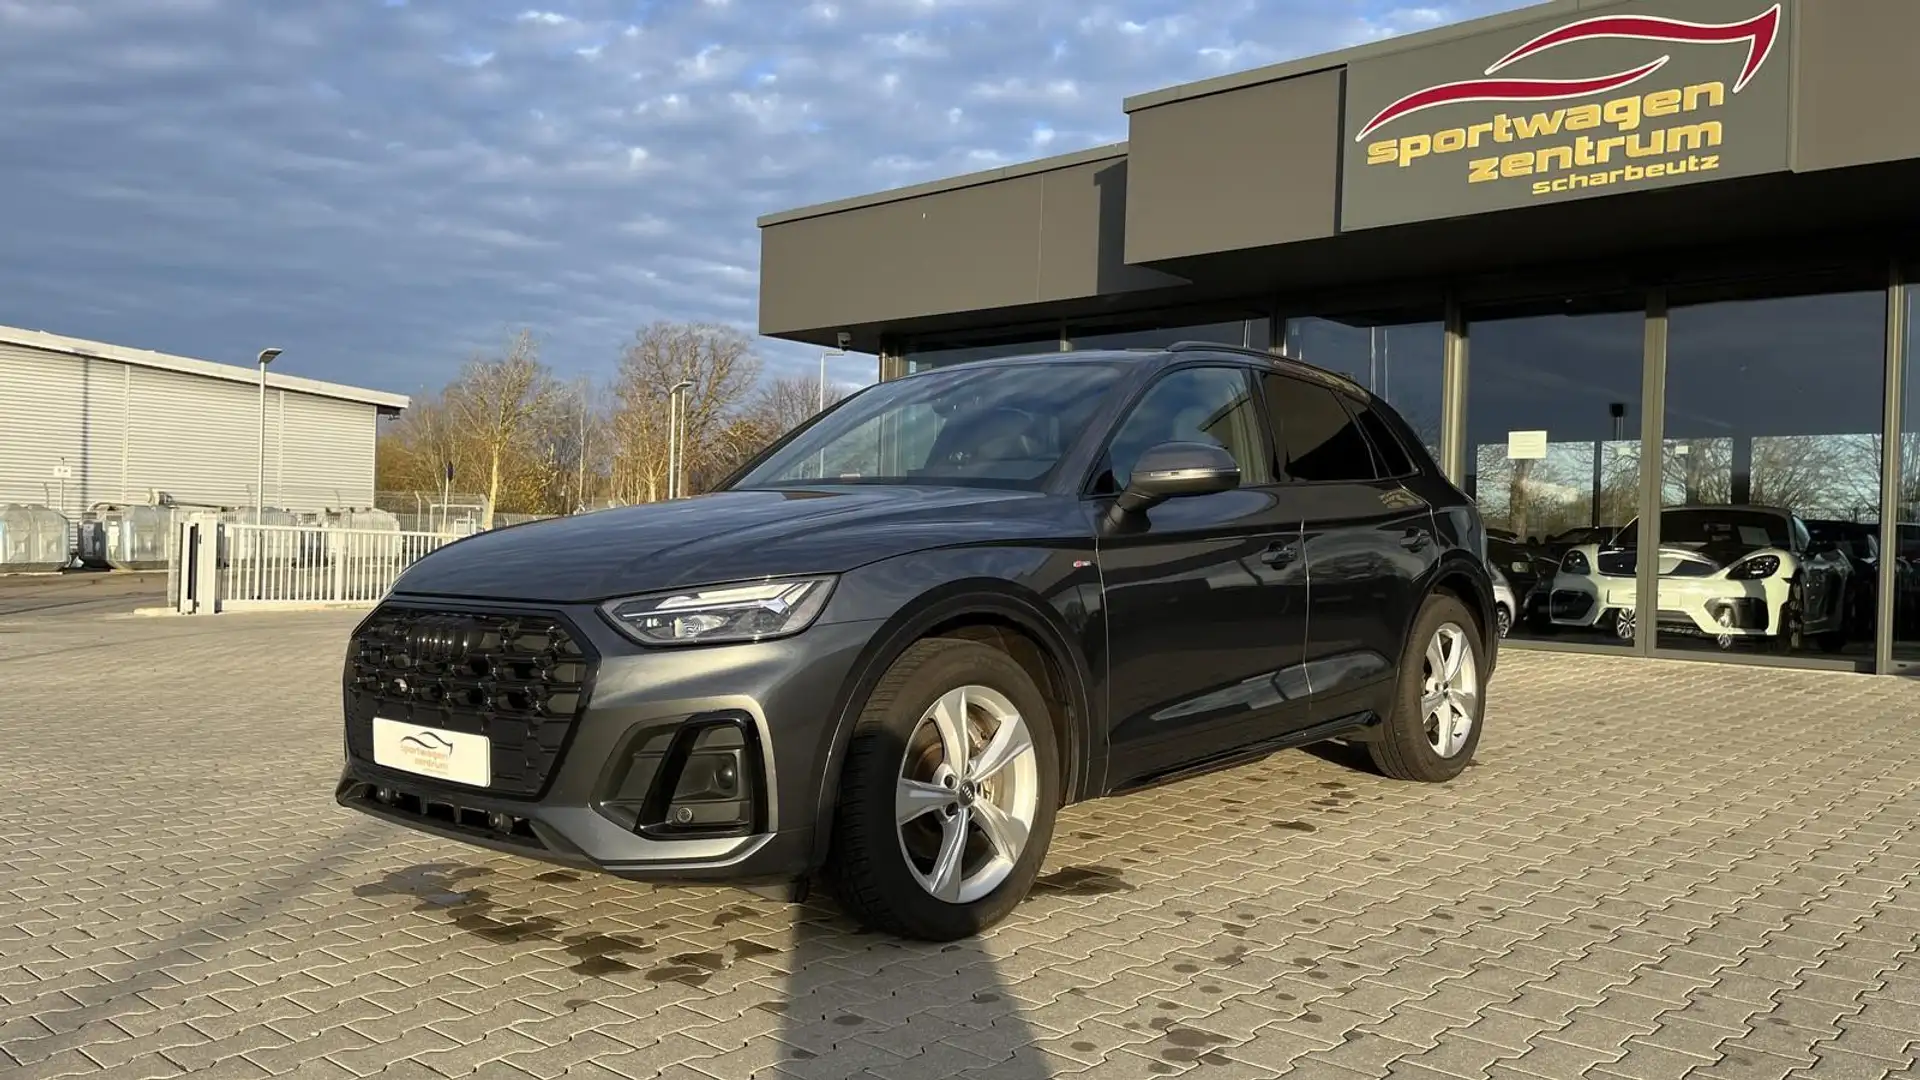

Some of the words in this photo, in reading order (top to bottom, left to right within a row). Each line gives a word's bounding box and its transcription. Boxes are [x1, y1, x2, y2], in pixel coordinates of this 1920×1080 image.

[1367, 81, 1725, 167] sportwagen
[1467, 120, 1723, 184] zentrum
[1532, 153, 1720, 196] scharbeutz
